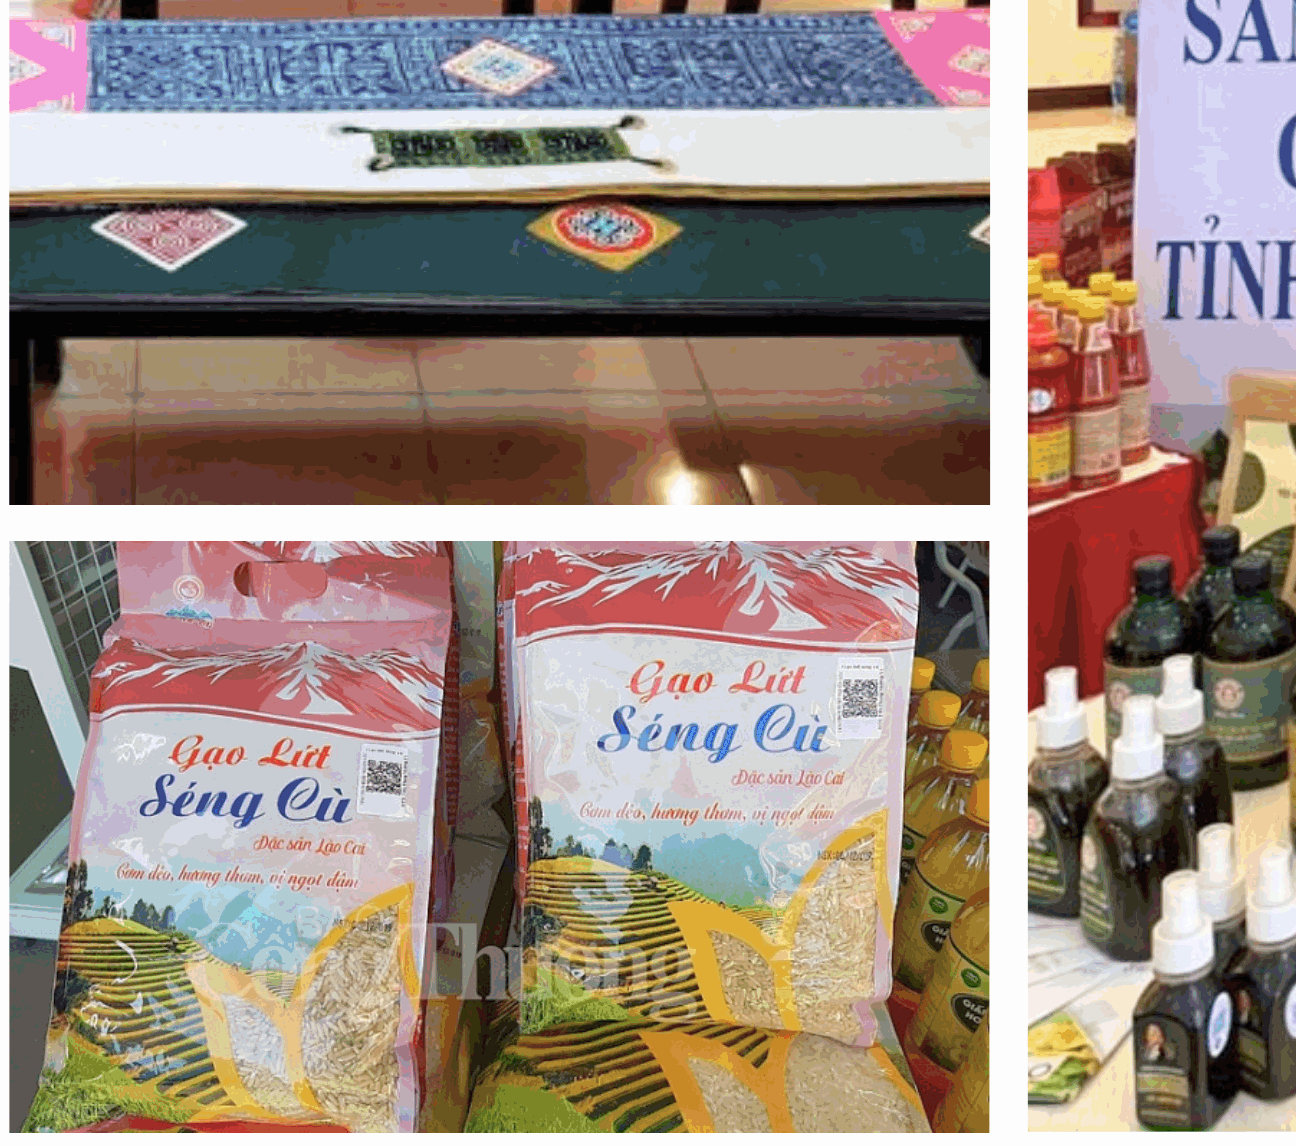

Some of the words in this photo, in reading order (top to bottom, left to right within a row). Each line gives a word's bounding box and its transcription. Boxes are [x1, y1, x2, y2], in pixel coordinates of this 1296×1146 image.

[626, 660, 717, 703] Gạo
[728, 660, 807, 695] Lứt
[597, 704, 743, 763] Séng
[753, 703, 830, 752] Cù
[168, 735, 247, 772] Gạo
[259, 737, 332, 770] Lứt
[732, 769, 763, 788] Đặc
[766, 769, 793, 786] sản
[796, 769, 822, 788] Lào
[824, 769, 844, 786] Cai
[139, 773, 264, 829] Séng
[278, 777, 352, 824] Cù
[254, 835, 285, 854] Đặc
[287, 838, 311, 853] sản
[315, 837, 342, 855] Lào
[344, 838, 366, 855] Cai
[178, 864, 221, 887] hương
[270, 871, 285, 889] vị
